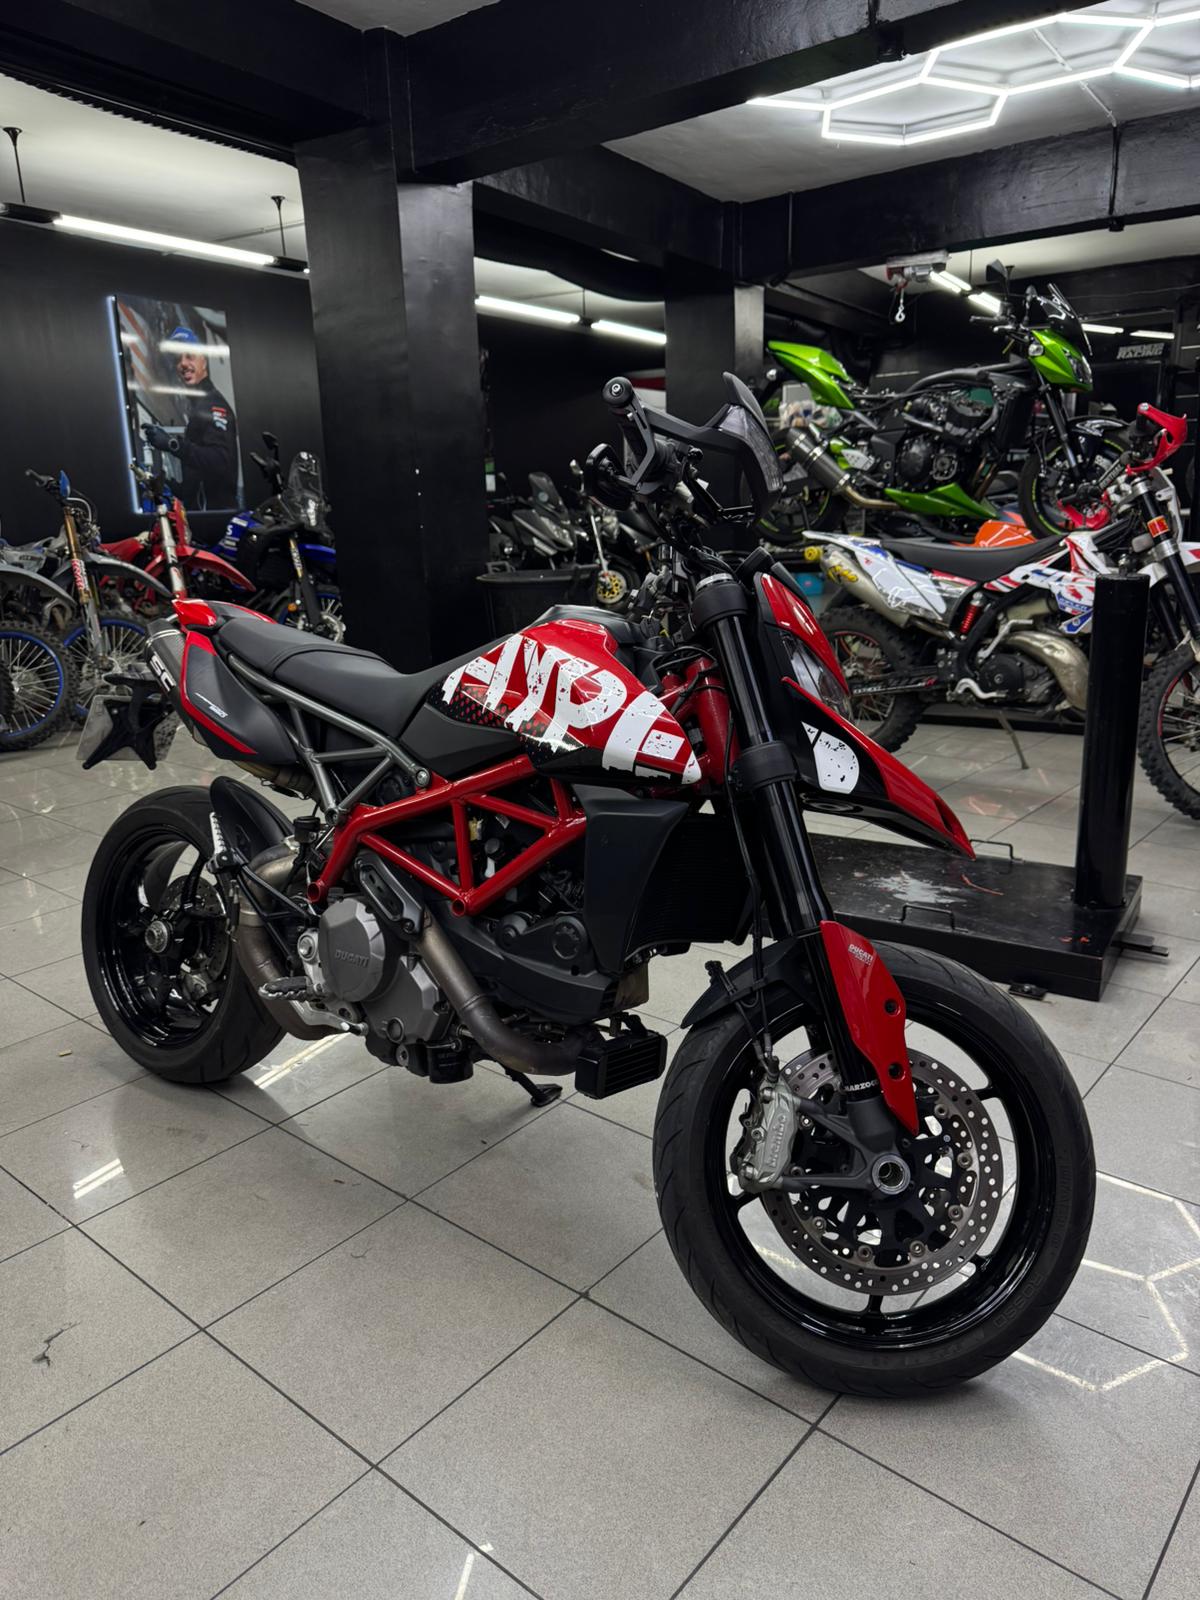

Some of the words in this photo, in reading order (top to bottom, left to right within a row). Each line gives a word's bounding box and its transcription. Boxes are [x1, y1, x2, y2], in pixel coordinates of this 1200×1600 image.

[334, 948, 370, 969] DUCATI
[848, 944, 874, 961] DUCATI
[994, 1274, 1044, 1329] ROSSO
